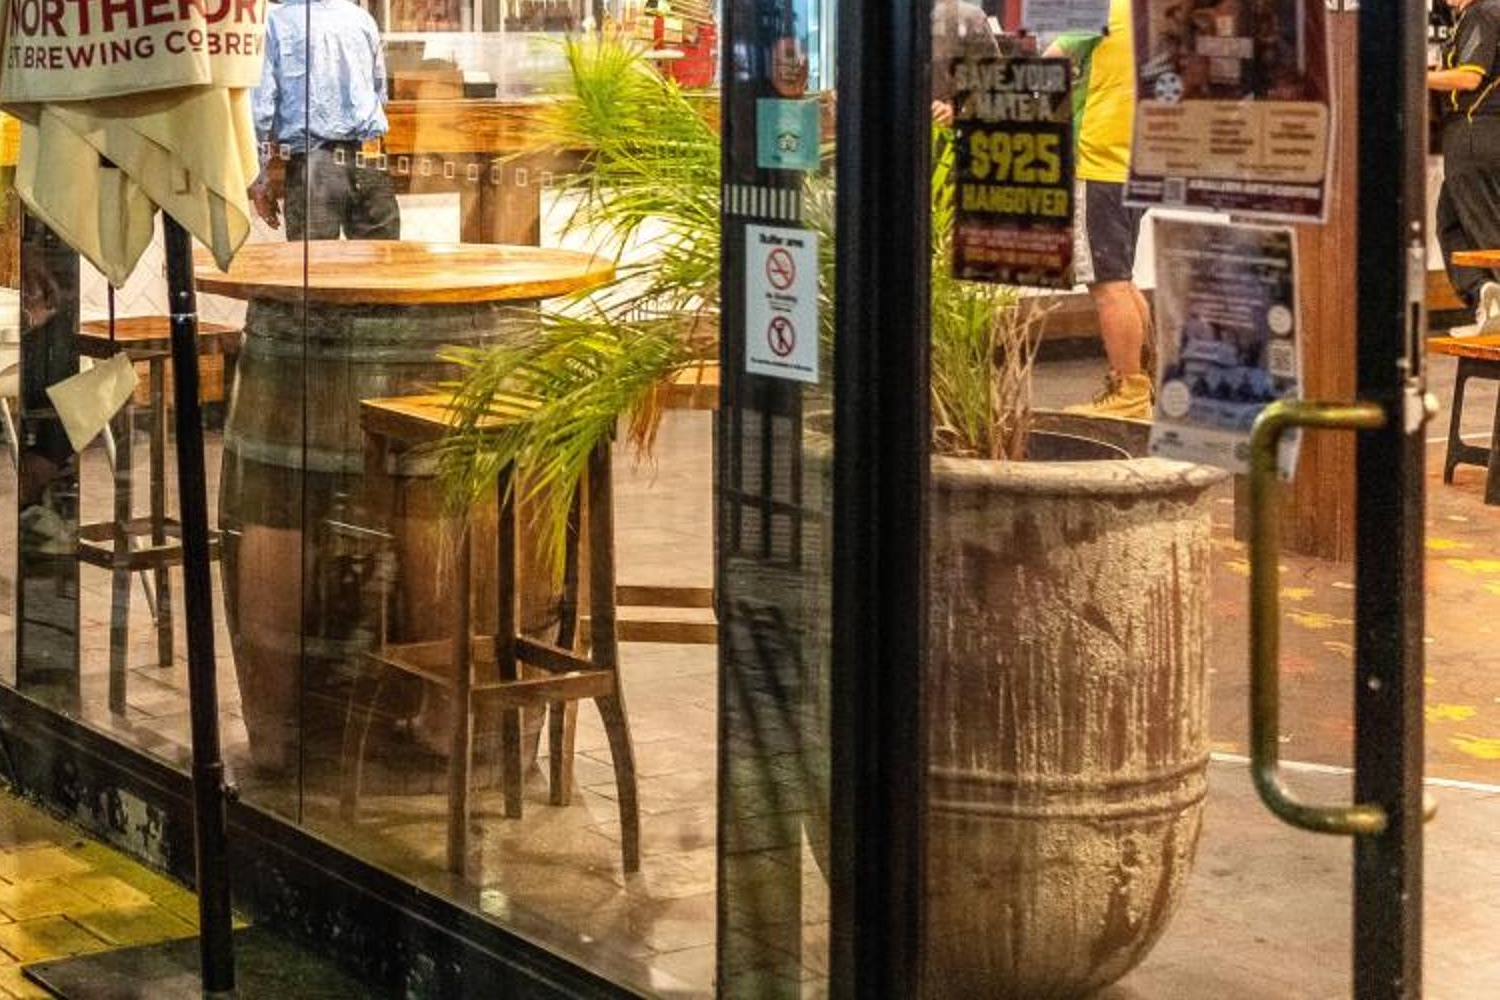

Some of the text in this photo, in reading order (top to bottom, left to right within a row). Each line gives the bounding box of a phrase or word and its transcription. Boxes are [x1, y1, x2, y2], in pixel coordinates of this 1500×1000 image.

[23, 36, 153, 69] BREWING
[969, 128, 1061, 183] $925
[961, 183, 1069, 217] HANGOVER
